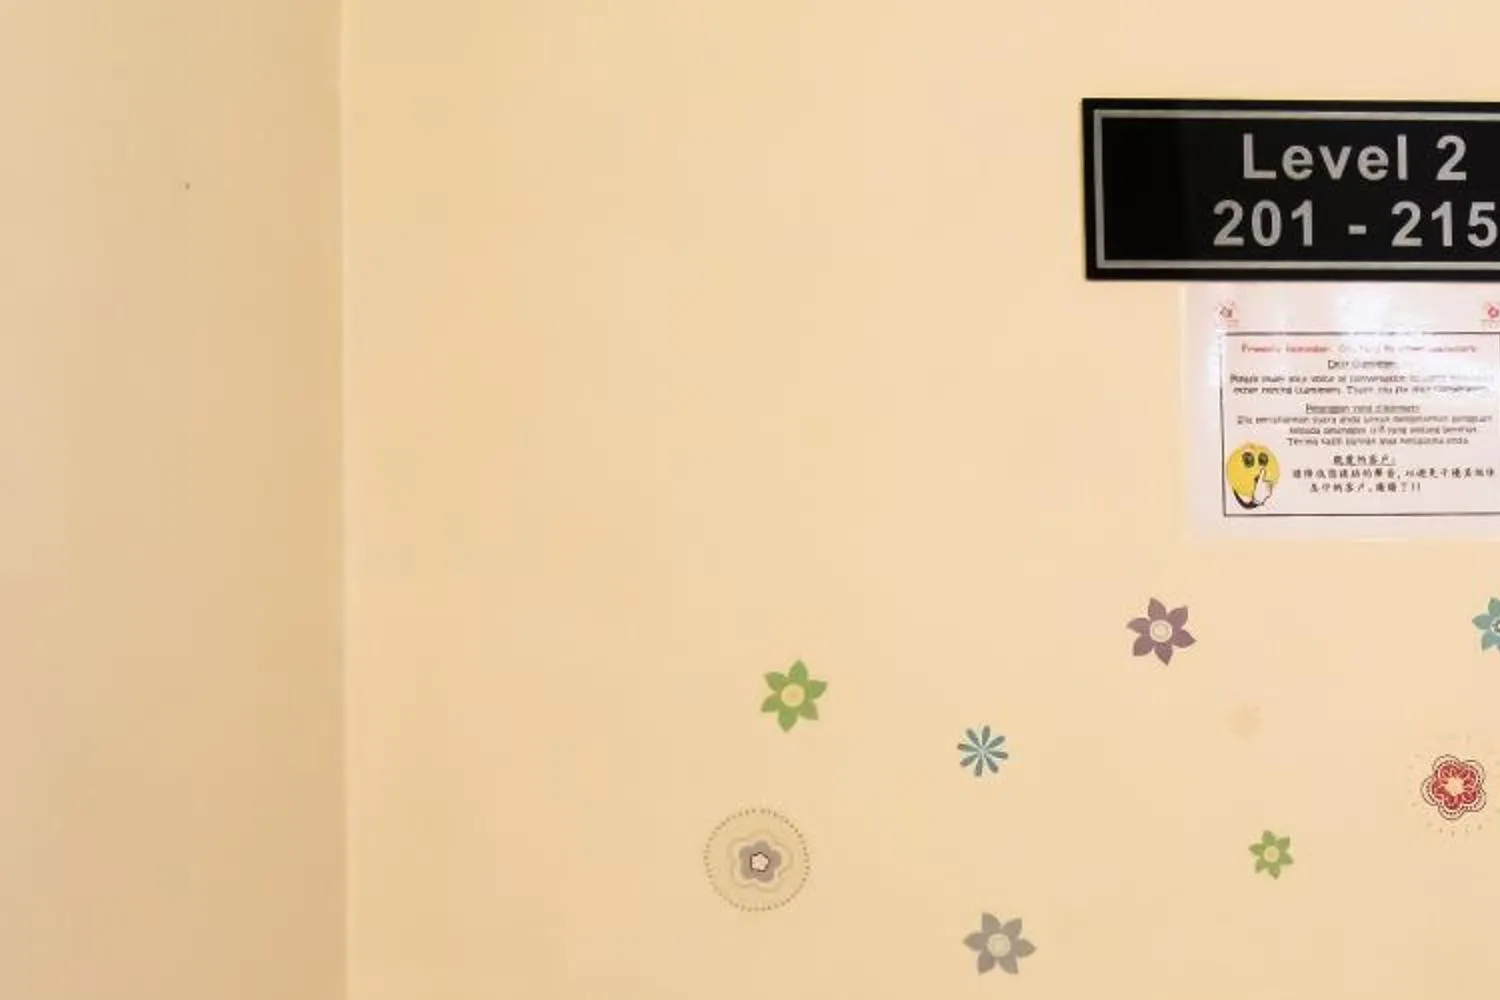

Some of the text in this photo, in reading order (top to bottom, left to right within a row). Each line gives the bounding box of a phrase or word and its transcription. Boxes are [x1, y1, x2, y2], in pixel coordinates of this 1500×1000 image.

[1242, 133, 1467, 181] Level 2
[1212, 199, 1499, 248] 201 - 215
